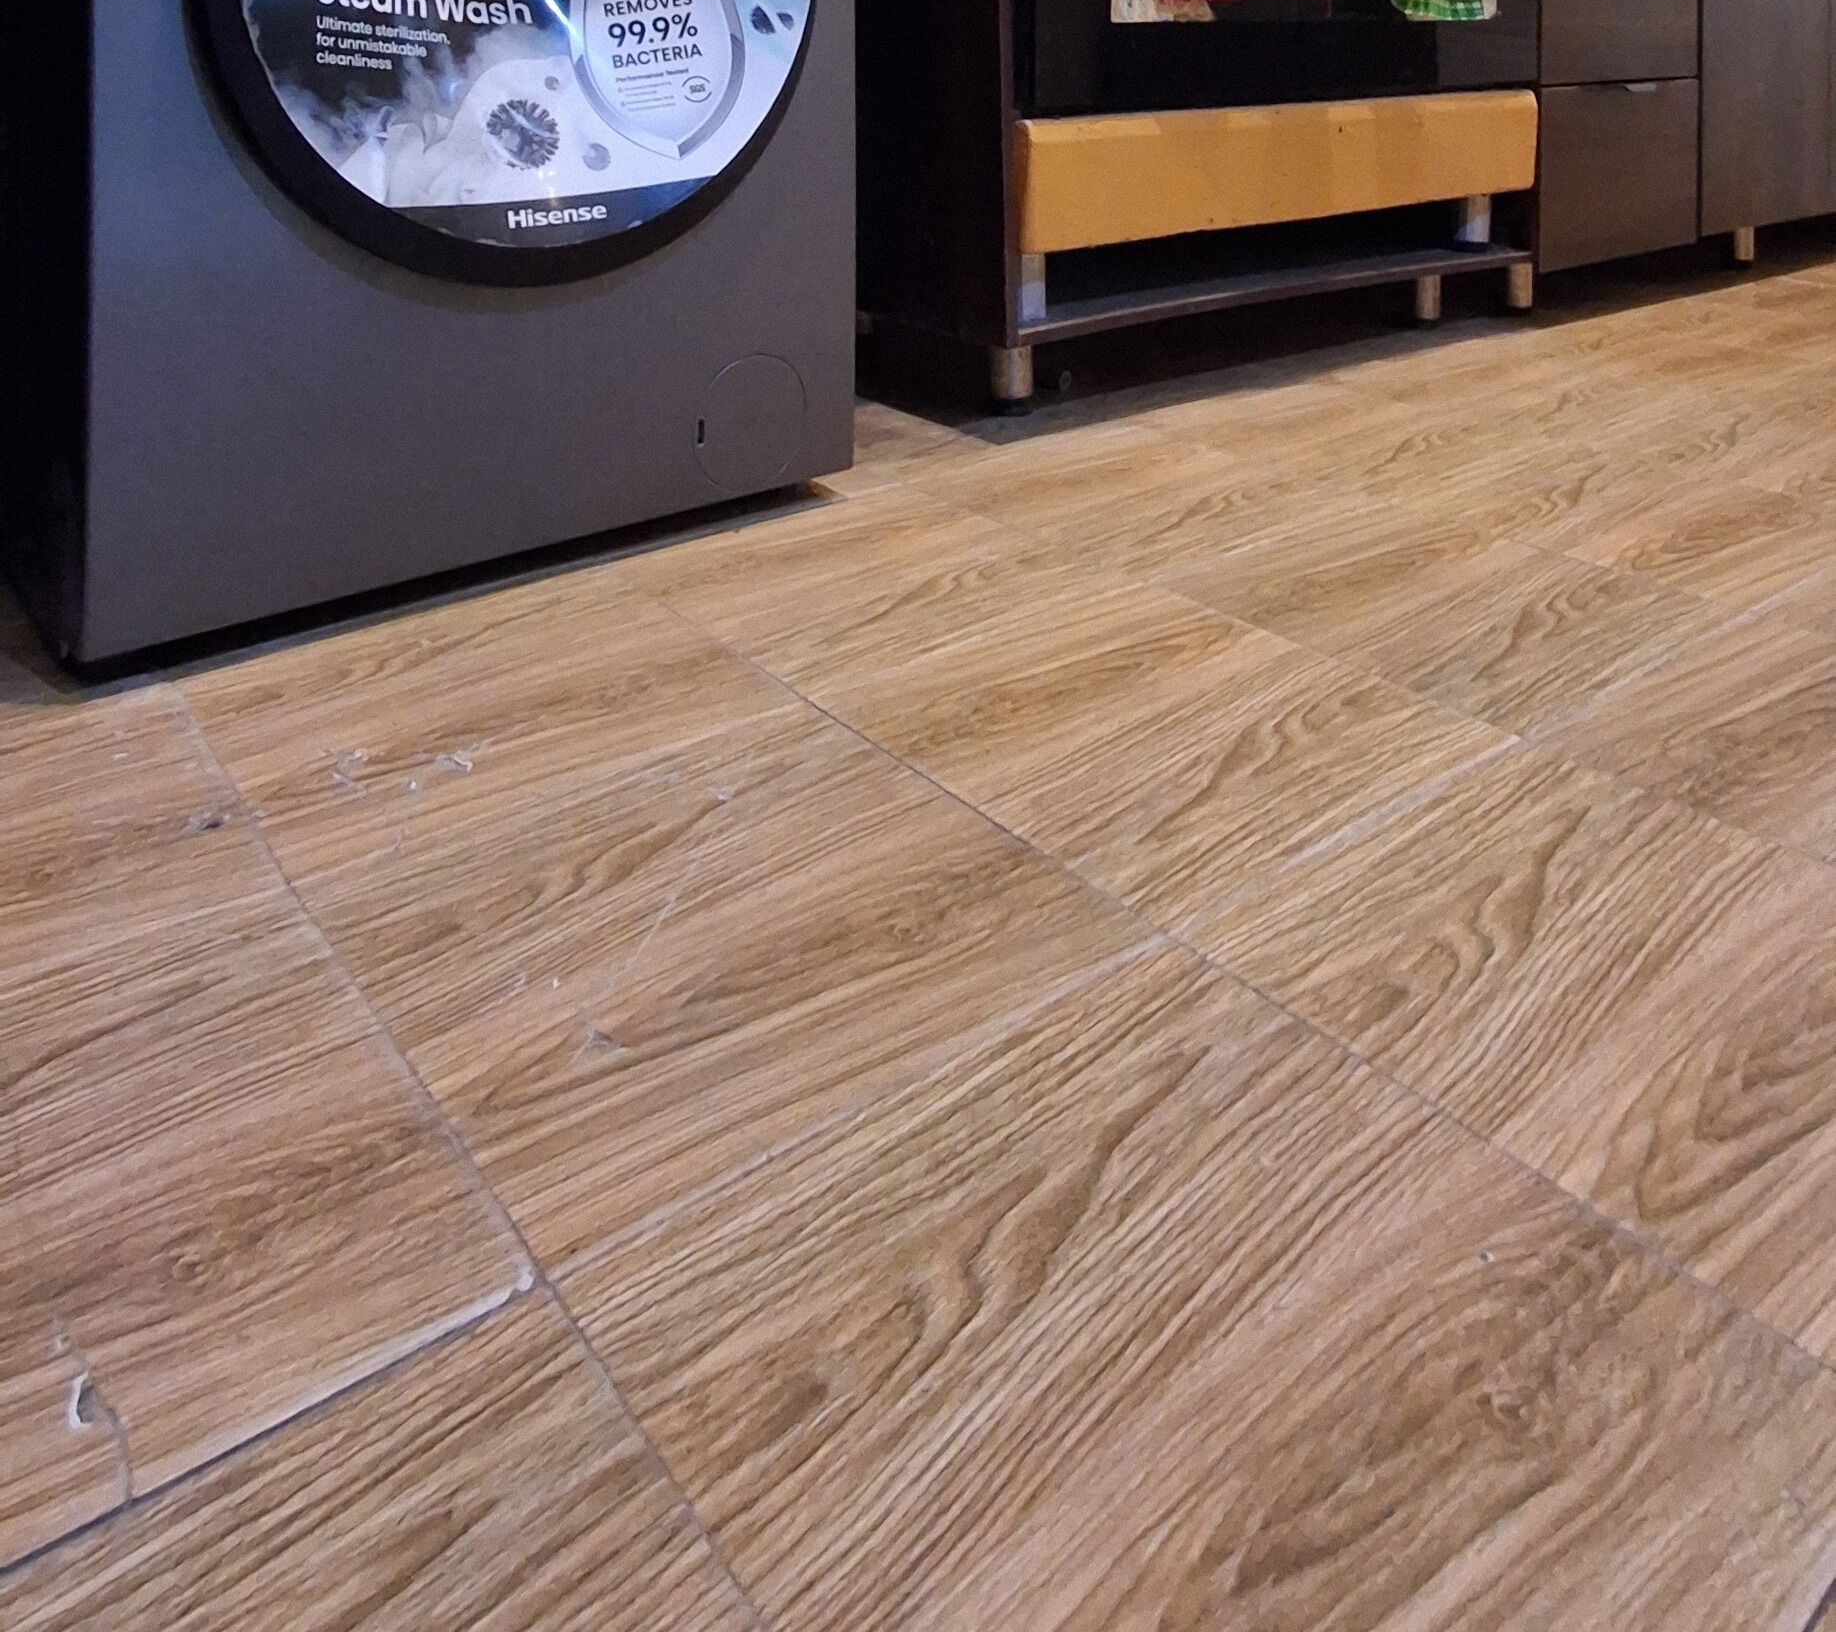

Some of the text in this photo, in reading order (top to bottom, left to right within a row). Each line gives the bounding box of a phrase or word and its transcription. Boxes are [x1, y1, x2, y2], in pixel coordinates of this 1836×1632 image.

[316, 15, 373, 35] Ultimate
[607, 11, 698, 48] 99.9%
[316, 32, 428, 58] for unmistakable
[611, 43, 703, 69] BACTERIA
[316, 50, 393, 70] cleanliness
[507, 204, 608, 230] Hisense
